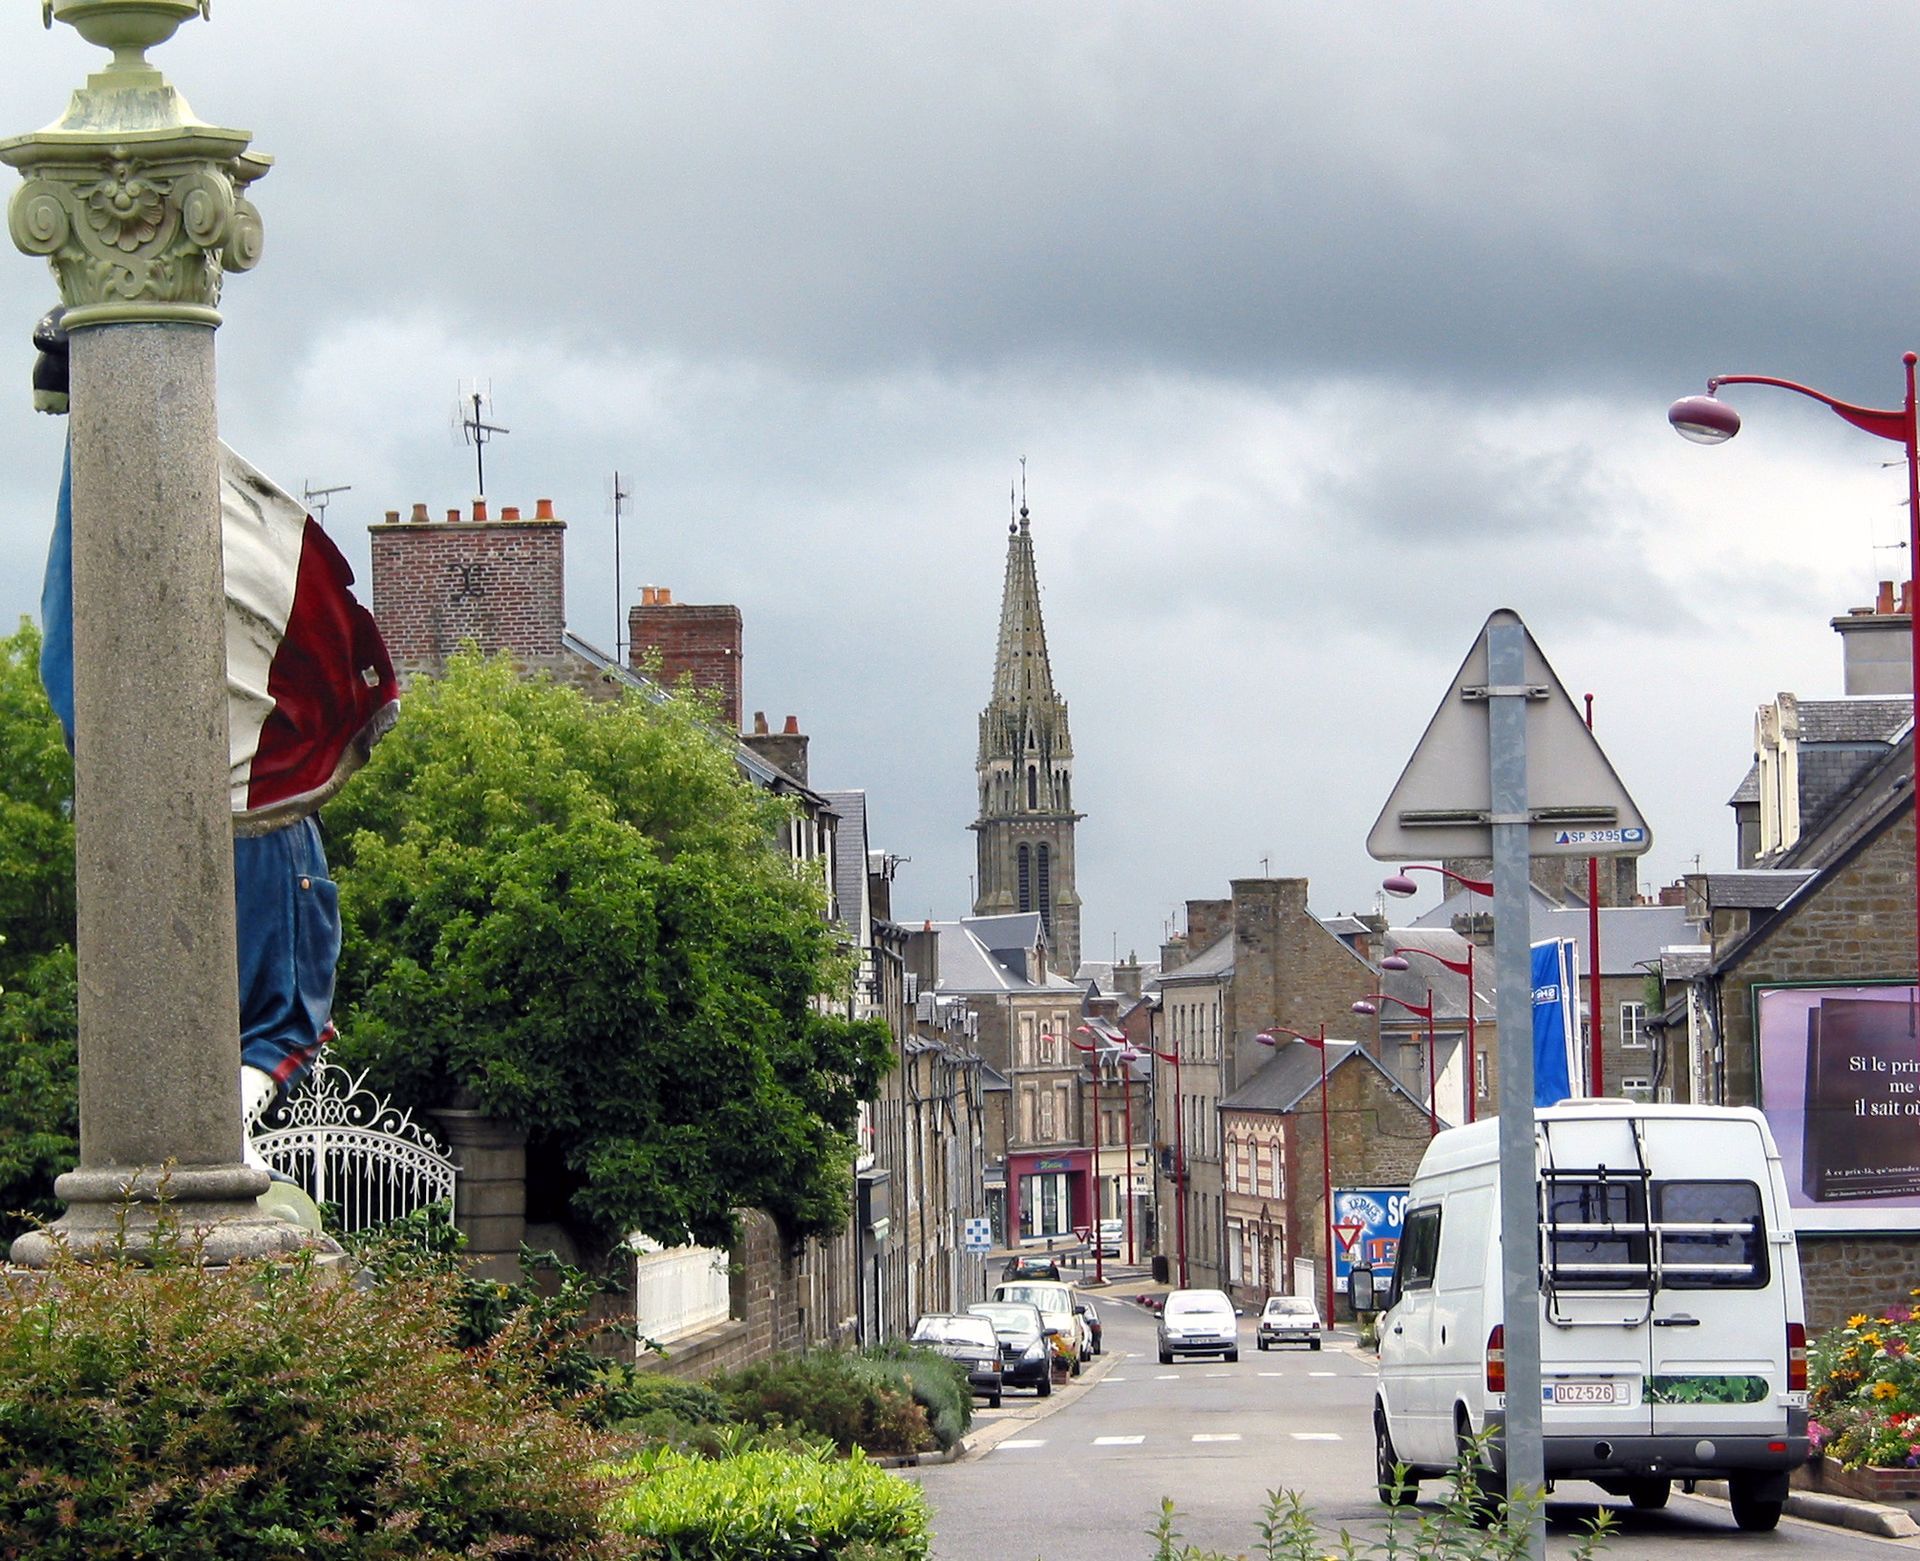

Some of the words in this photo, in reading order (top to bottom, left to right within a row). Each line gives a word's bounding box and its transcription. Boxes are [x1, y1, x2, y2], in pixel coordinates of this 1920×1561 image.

[1571, 831, 1586, 843] SP
[1590, 830, 1621, 842] 3295
[1849, 1056, 1866, 1071] Si
[1872, 1056, 1887, 1071] le
[1889, 1082, 1915, 1093] me
[1854, 1098, 1866, 1116] il
[1870, 1100, 1900, 1116] sait
